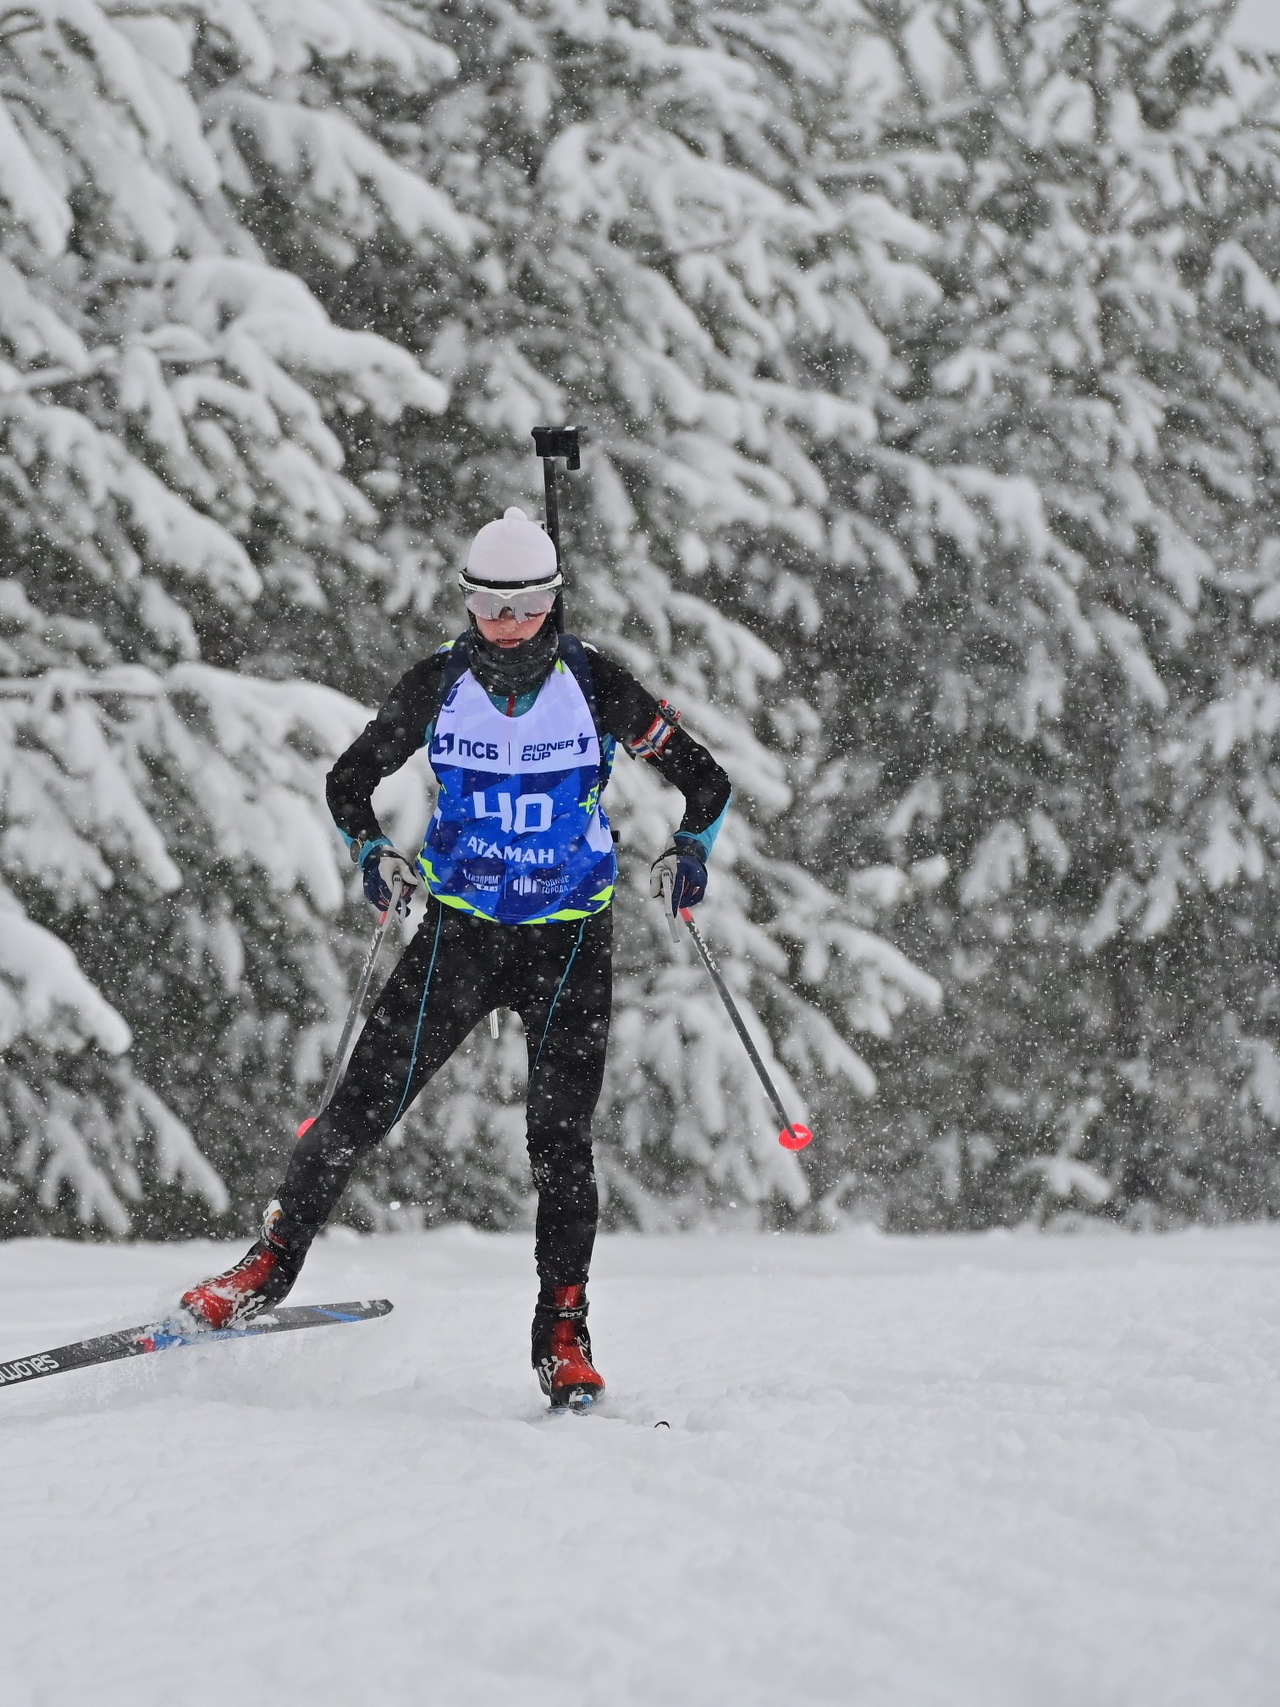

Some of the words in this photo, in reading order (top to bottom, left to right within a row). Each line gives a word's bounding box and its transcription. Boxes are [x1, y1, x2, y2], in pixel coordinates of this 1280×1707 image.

[458, 738, 499, 761] ПСБ
[521, 751, 551, 762] CUP
[522, 739, 574, 753] PIONER
[473, 791, 554, 834] 40
[467, 835, 554, 865] АТАМАН
